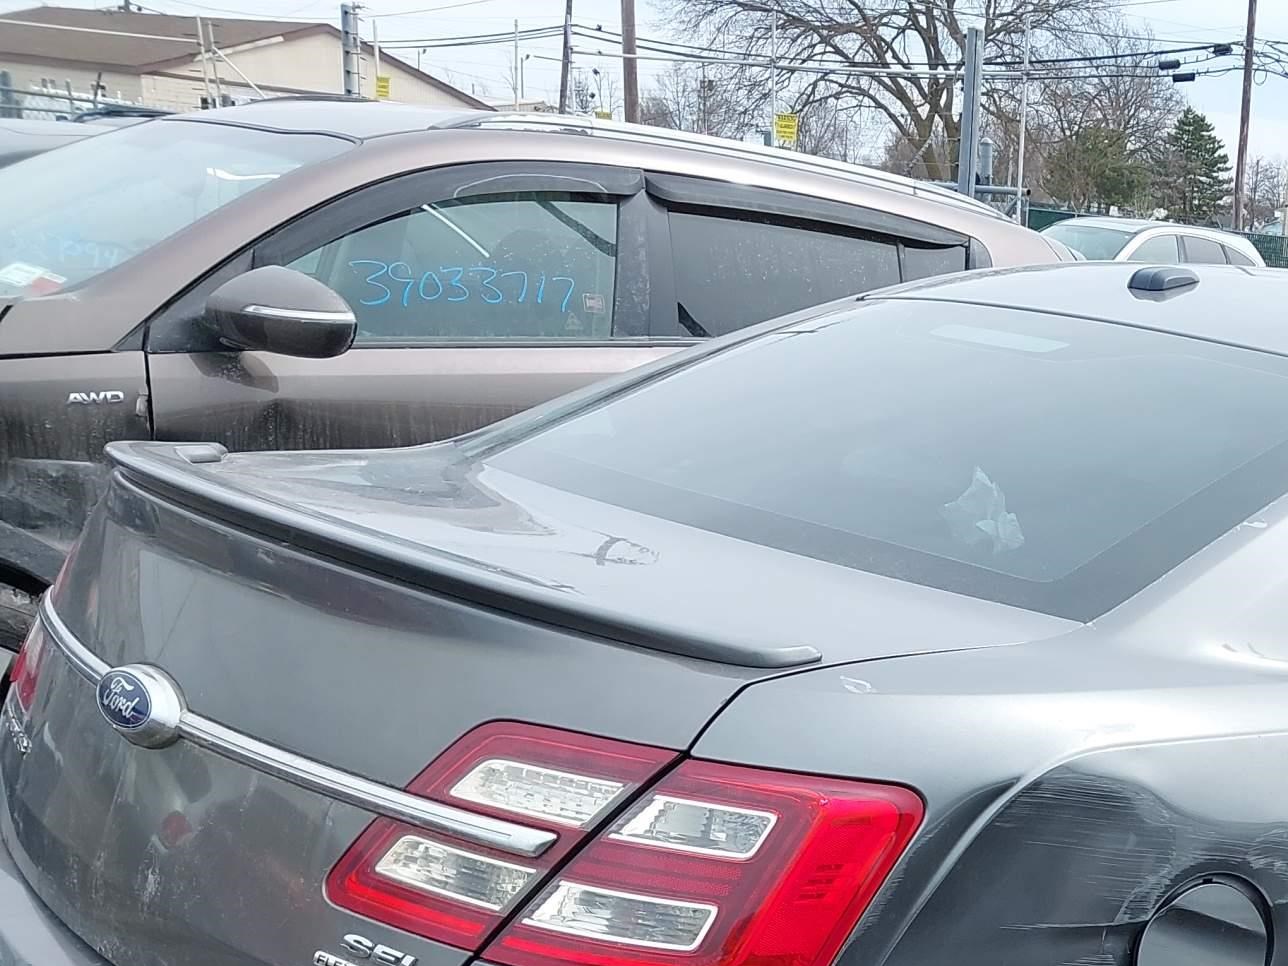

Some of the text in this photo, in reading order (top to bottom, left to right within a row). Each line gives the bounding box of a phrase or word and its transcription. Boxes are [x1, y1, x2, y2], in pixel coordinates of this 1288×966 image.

[349, 260, 576, 313] 39033717
[66, 391, 124, 405] AWD
[102, 676, 148, 719] Ford
